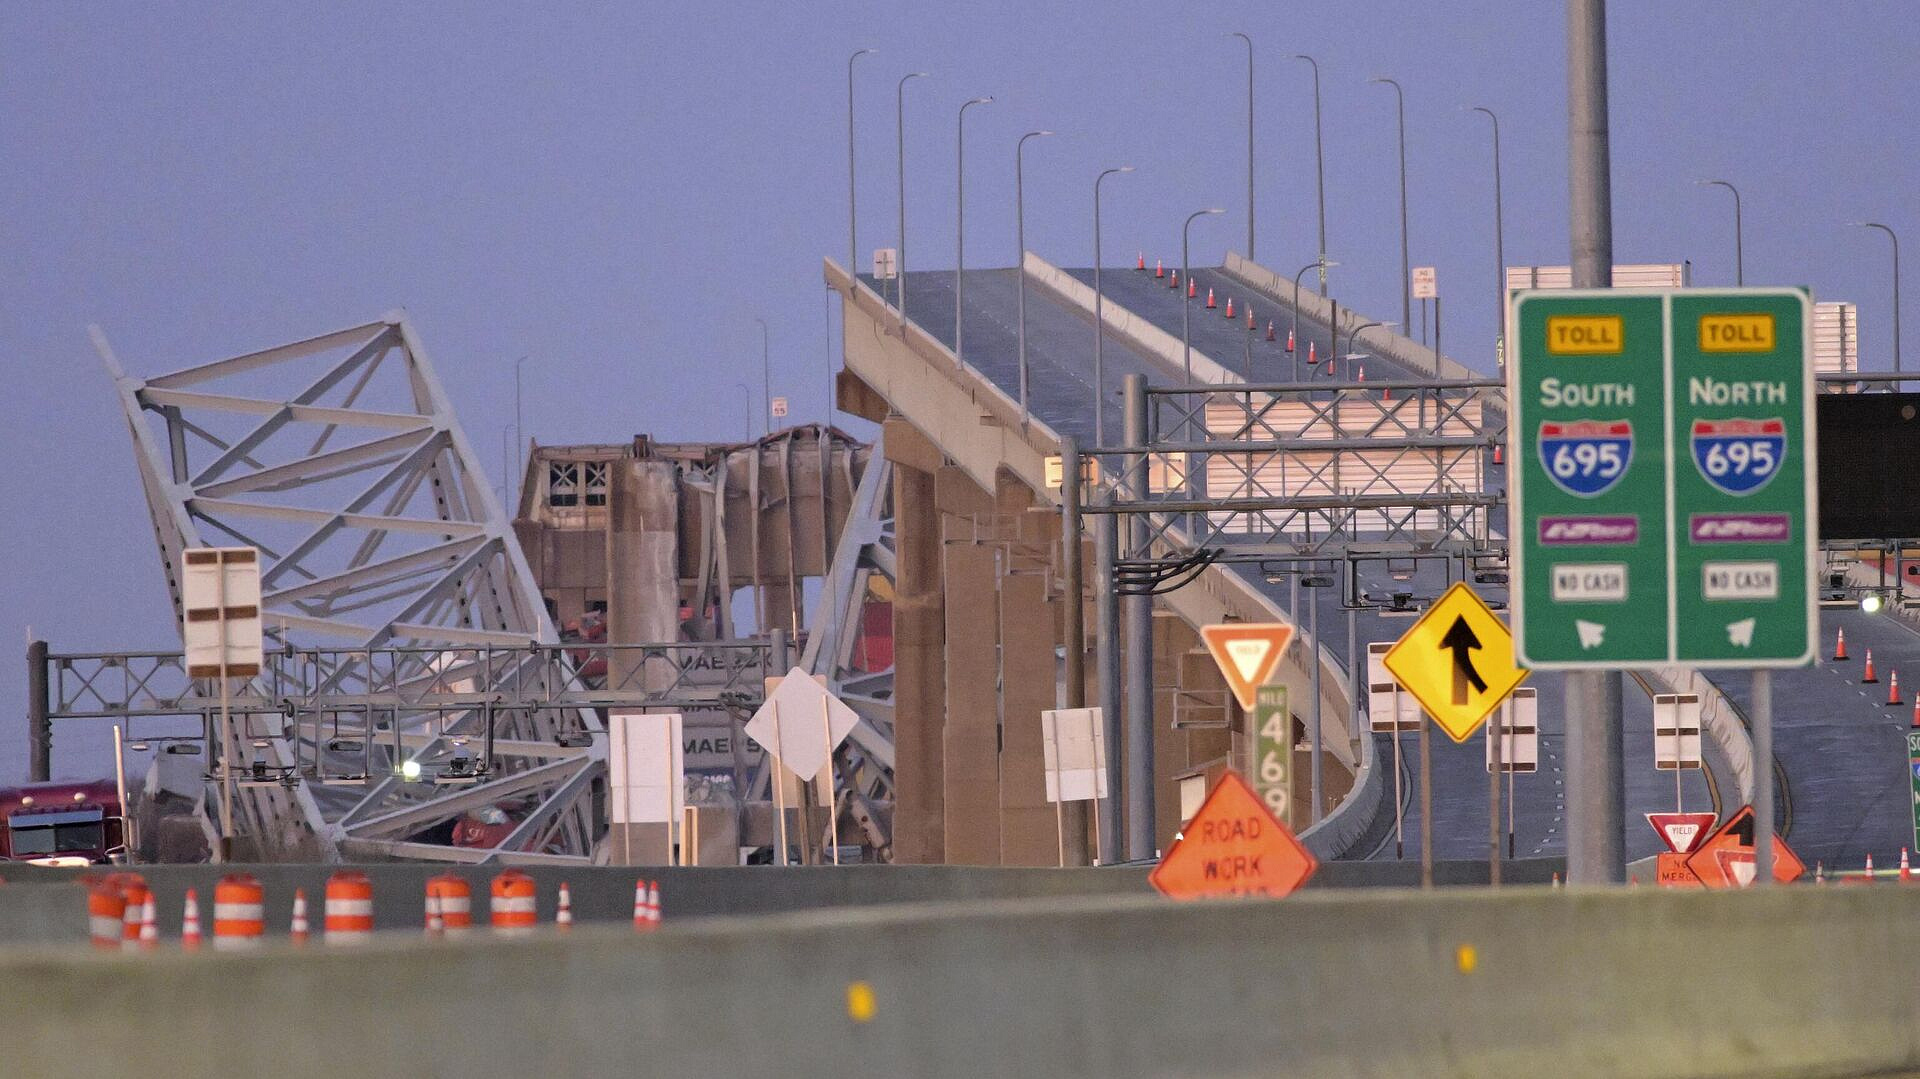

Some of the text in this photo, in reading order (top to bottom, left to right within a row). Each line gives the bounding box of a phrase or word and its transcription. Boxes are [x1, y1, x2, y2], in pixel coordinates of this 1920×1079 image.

[1557, 325, 1614, 345] TOLL
[1708, 324, 1766, 342] TOLL
[1540, 377, 1635, 407] SOUTH
[1689, 376, 1787, 406] NORTH
[1553, 442, 1621, 478] 695
[1706, 441, 1774, 476] 695
[1558, 572, 1620, 591] NO CASH
[1710, 571, 1771, 590] NO CASH
[1202, 817, 1261, 842] ROAD
[1672, 826, 1693, 835] YIELD
[1662, 872, 1697, 881] MERG
